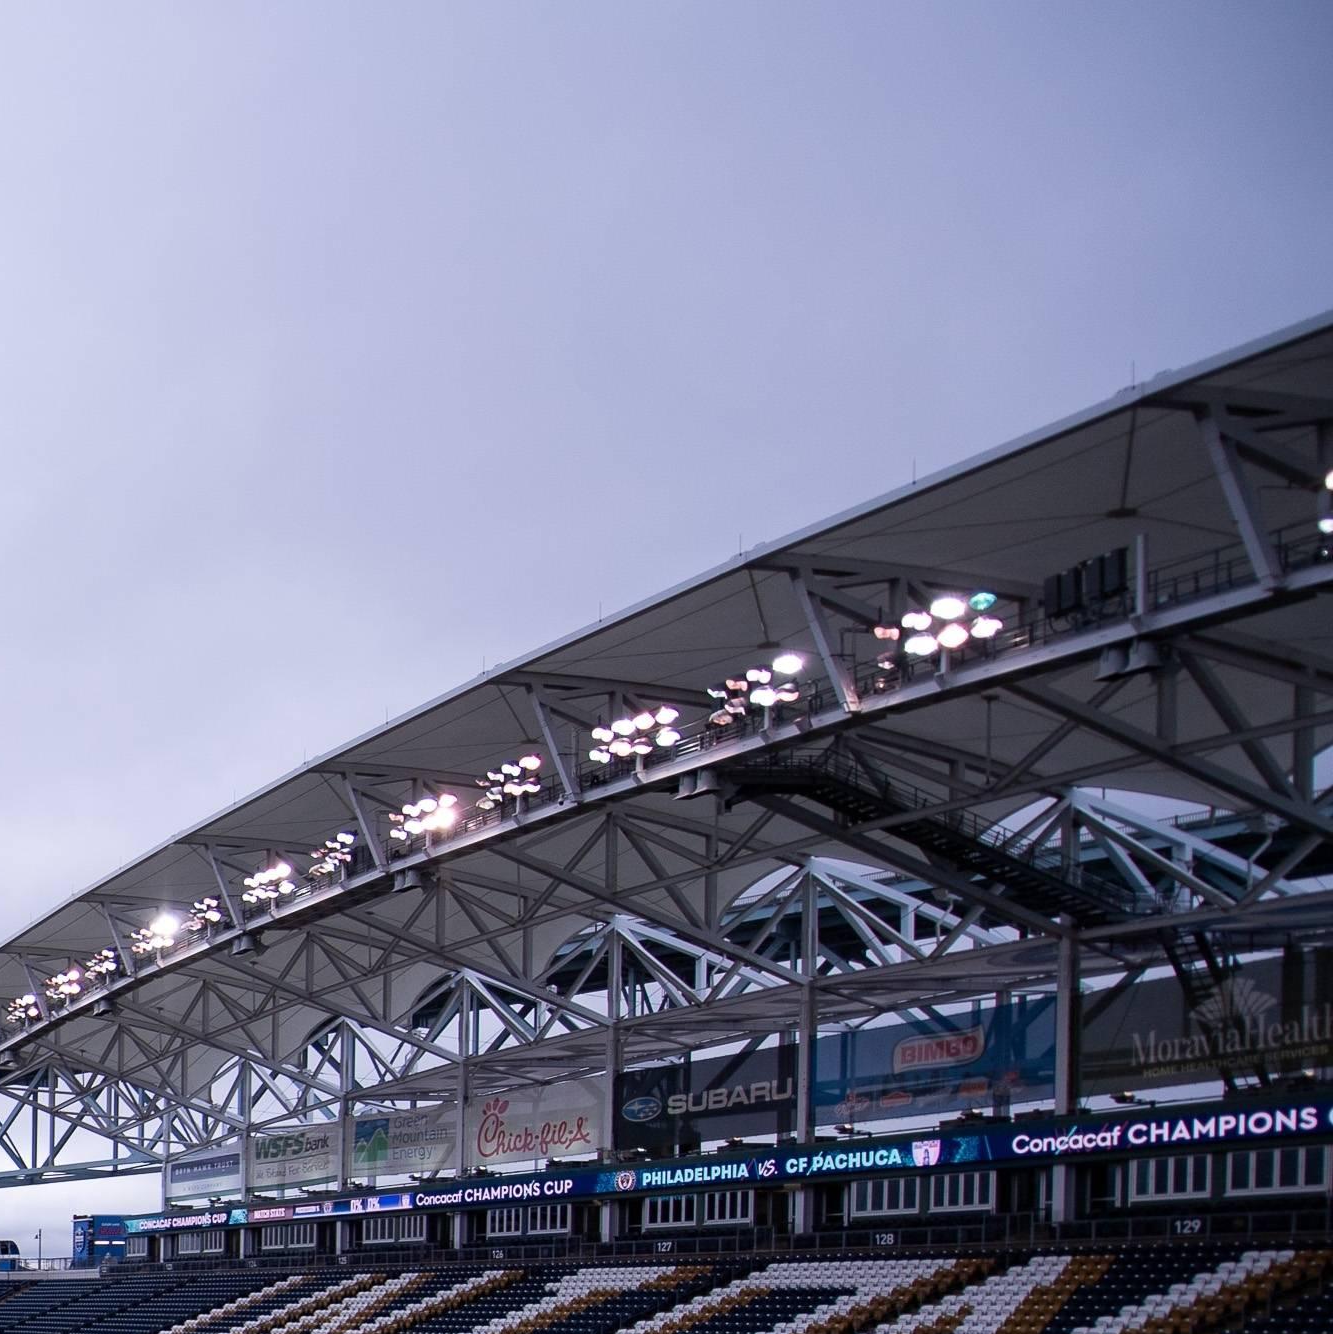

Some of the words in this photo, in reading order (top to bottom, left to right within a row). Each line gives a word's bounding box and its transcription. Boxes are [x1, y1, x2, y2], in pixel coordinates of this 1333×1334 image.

[900, 1036, 979, 1065] BIMBO
[1143, 1066, 1176, 1079] HOME
[666, 1077, 795, 1115] SUBARU
[393, 1113, 429, 1129] Green
[392, 1127, 448, 1144] Mountain
[477, 1110, 590, 1158] Chick-fil-A
[1011, 1125, 1121, 1156] Concacaf
[1127, 1107, 1318, 1147] CHAMPIONS
[254, 1133, 305, 1160] WSFS
[305, 1132, 331, 1154] bank
[392, 1146, 433, 1160] Energy
[214, 1160, 234, 1169] TRUST
[642, 1163, 749, 1188] PHILADELPHIA
[785, 1155, 808, 1176] CF
[811, 1148, 903, 1174] PACHUCA
[416, 1189, 462, 1207] Concacaf
[464, 1181, 541, 1203] CHAMPIONS
[543, 1178, 573, 1195] CUP
[139, 1217, 171, 1230] CONCACAF
[171, 1214, 211, 1228] CHAMPIONS
[212, 1212, 227, 1224] CUP
[253, 1208, 270, 1219] MATCH
[270, 1206, 286, 1218] STATS
[1174, 1218, 1201, 1235] 129
[656, 1240, 672, 1253] 127
[874, 1233, 895, 1246] 128
[492, 1249, 504, 1259] 126
